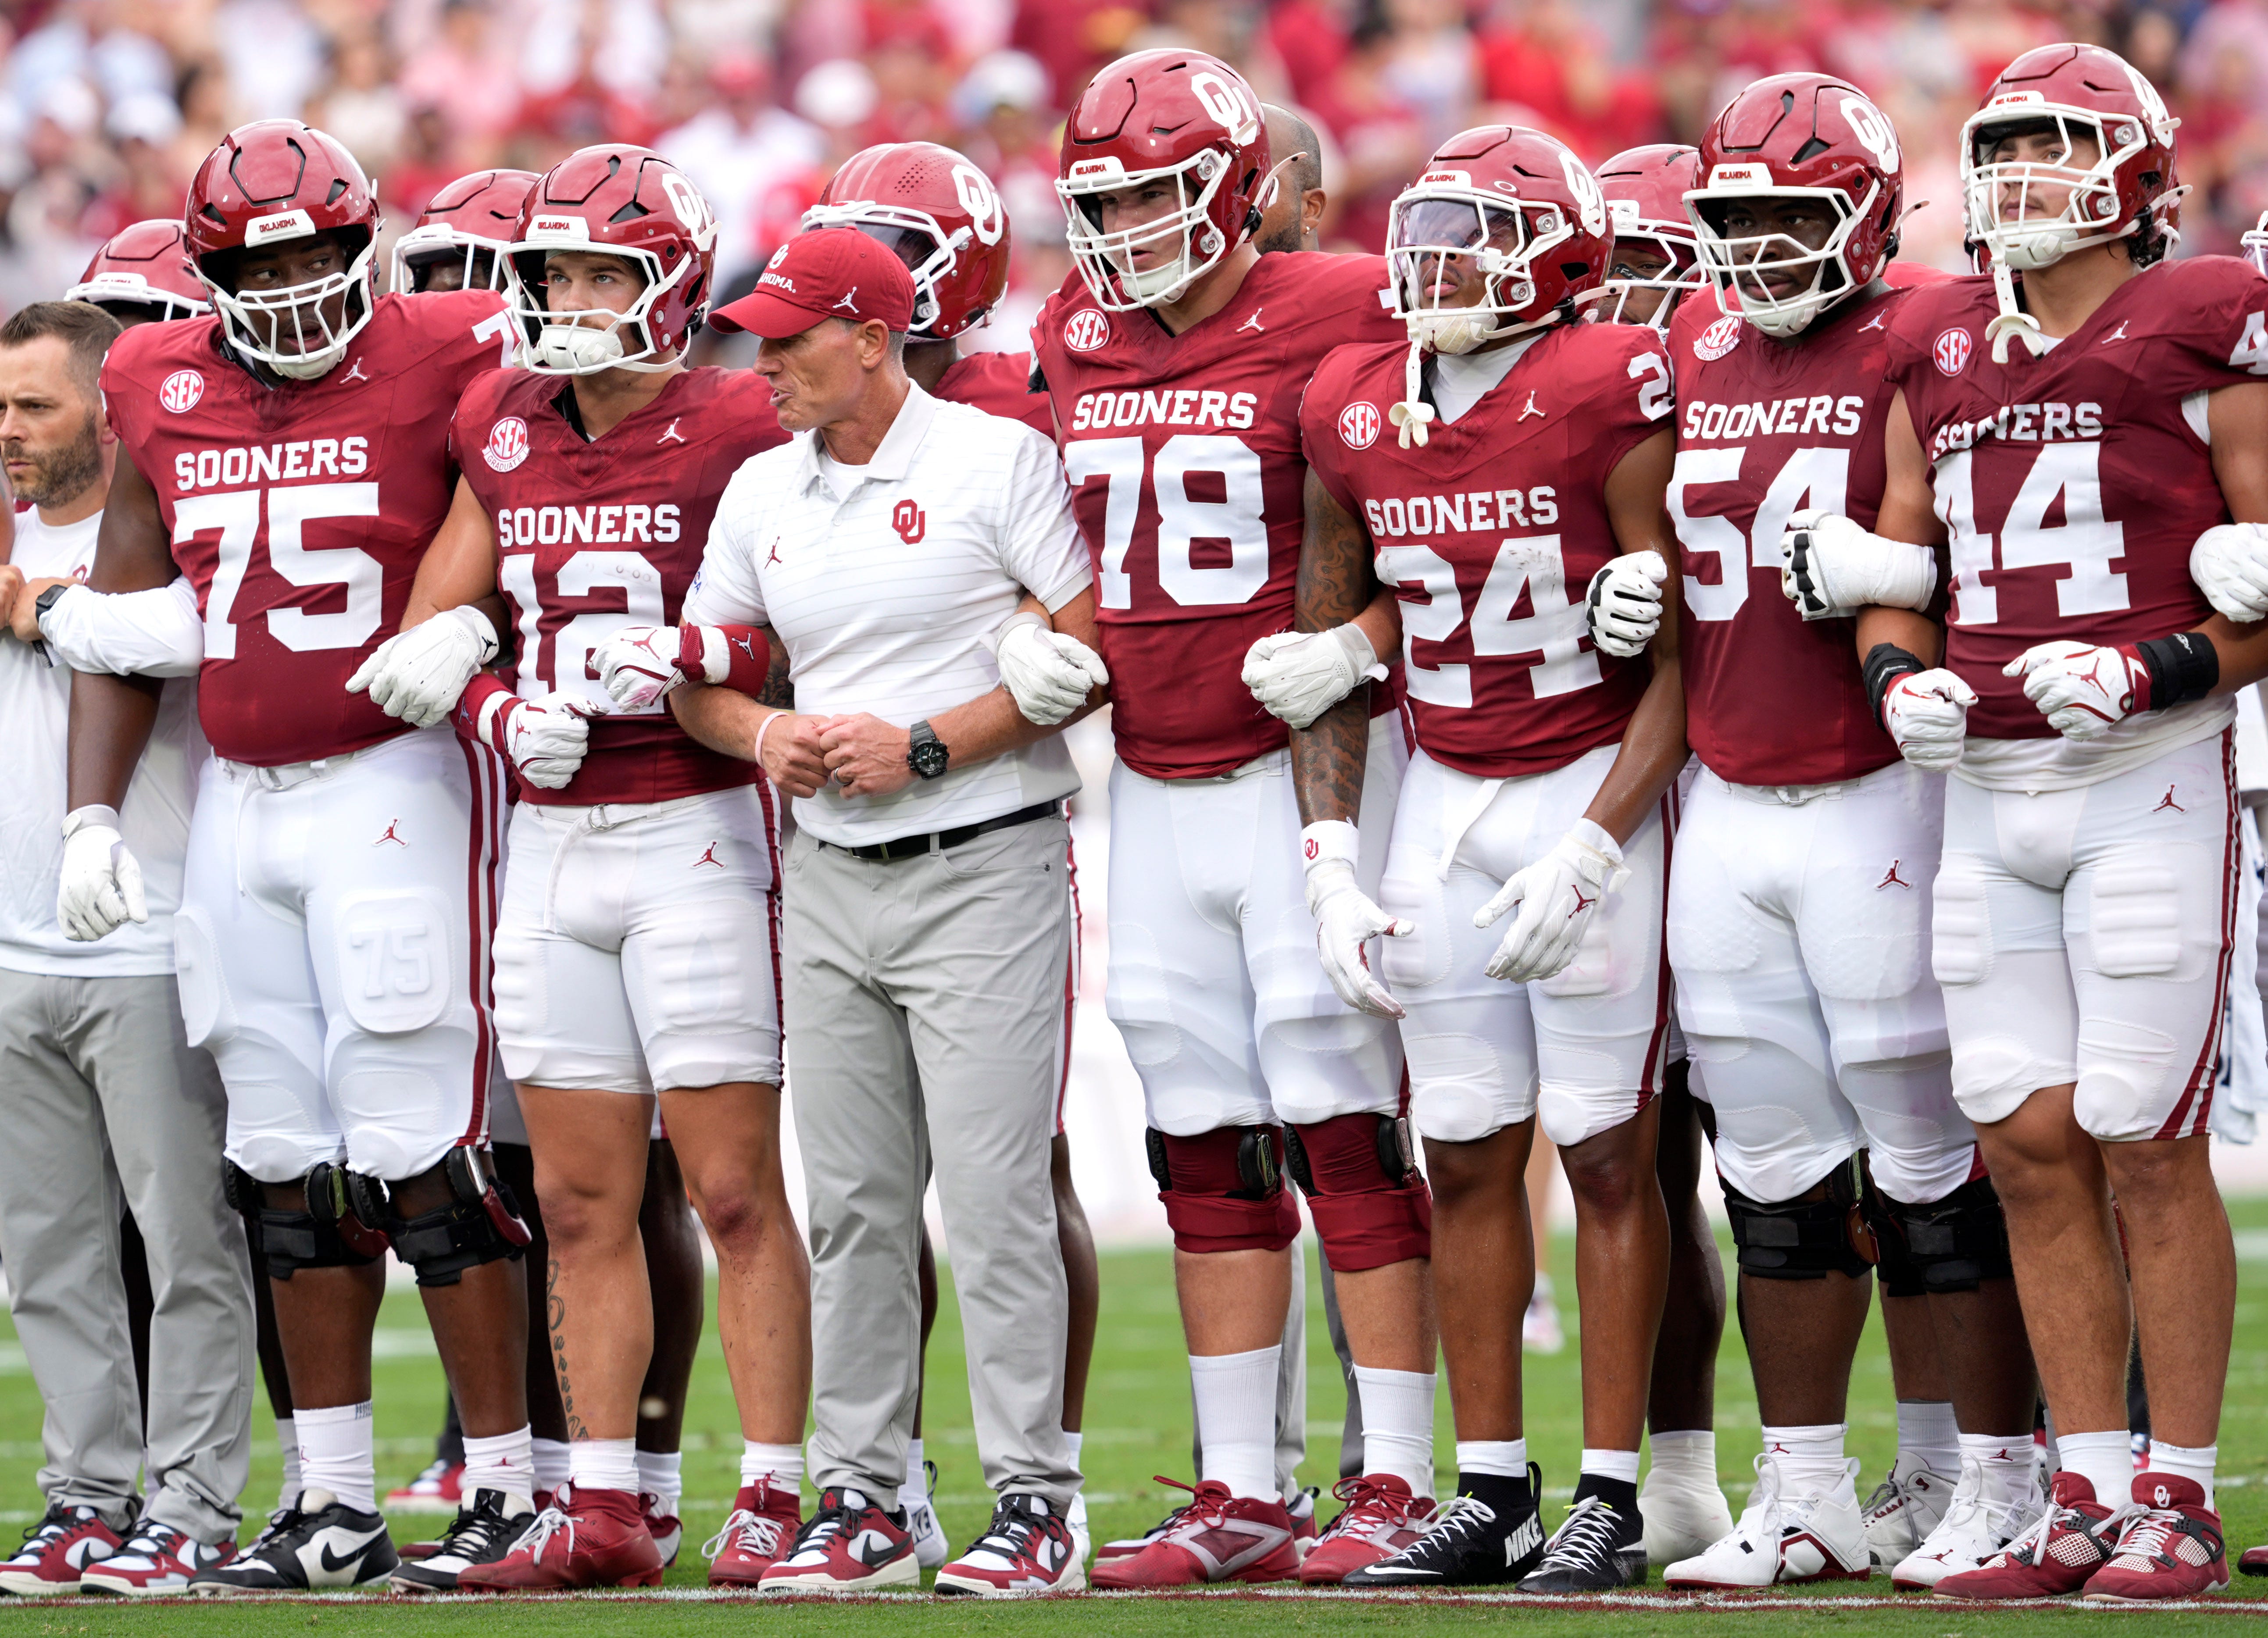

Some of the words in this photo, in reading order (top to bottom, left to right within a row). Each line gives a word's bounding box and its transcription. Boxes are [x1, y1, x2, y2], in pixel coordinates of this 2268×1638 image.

[1191, 72, 1257, 146] OU
[1840, 98, 1899, 175] OU
[1075, 164, 1107, 175] OKLAHOMA
[1718, 171, 1751, 179] OKLAHOMA
[259, 218, 296, 233] OKLAHOMA
[538, 221, 570, 230] OKLAHOMA
[951, 164, 1003, 246] OU
[768, 244, 789, 269] OU
[1067, 311, 1105, 350] SEC
[1695, 344, 1731, 360] GRADUATE
[1704, 316, 1740, 349] SEC
[1936, 331, 1969, 373] SEC
[163, 371, 201, 412] SEC
[1627, 348, 1675, 421] 2
[1072, 390, 1257, 431] SOONERS
[1341, 404, 1378, 448] SEC
[1682, 395, 1864, 440] SOONERS
[1931, 402, 2103, 460] SONERS
[492, 419, 525, 459] SEC
[175, 436, 368, 491] SOONERS
[482, 455, 524, 471] GRADUATE
[498, 504, 680, 548] SOONERS
[892, 499, 925, 545] OU
[1064, 435, 1269, 610] 78
[1365, 485, 1558, 536] SOONERS
[1666, 446, 1856, 622] 54
[1932, 441, 2131, 626] 44
[173, 482, 383, 660] 75
[501, 551, 665, 716] 12
[1374, 533, 1604, 709] 24
[1305, 838, 1319, 860] OU
[351, 923, 432, 999] 75
[824, 1492, 837, 1510] OU
[2154, 1485, 2171, 1508] OU
[1504, 1511, 1543, 1568] NIKE
